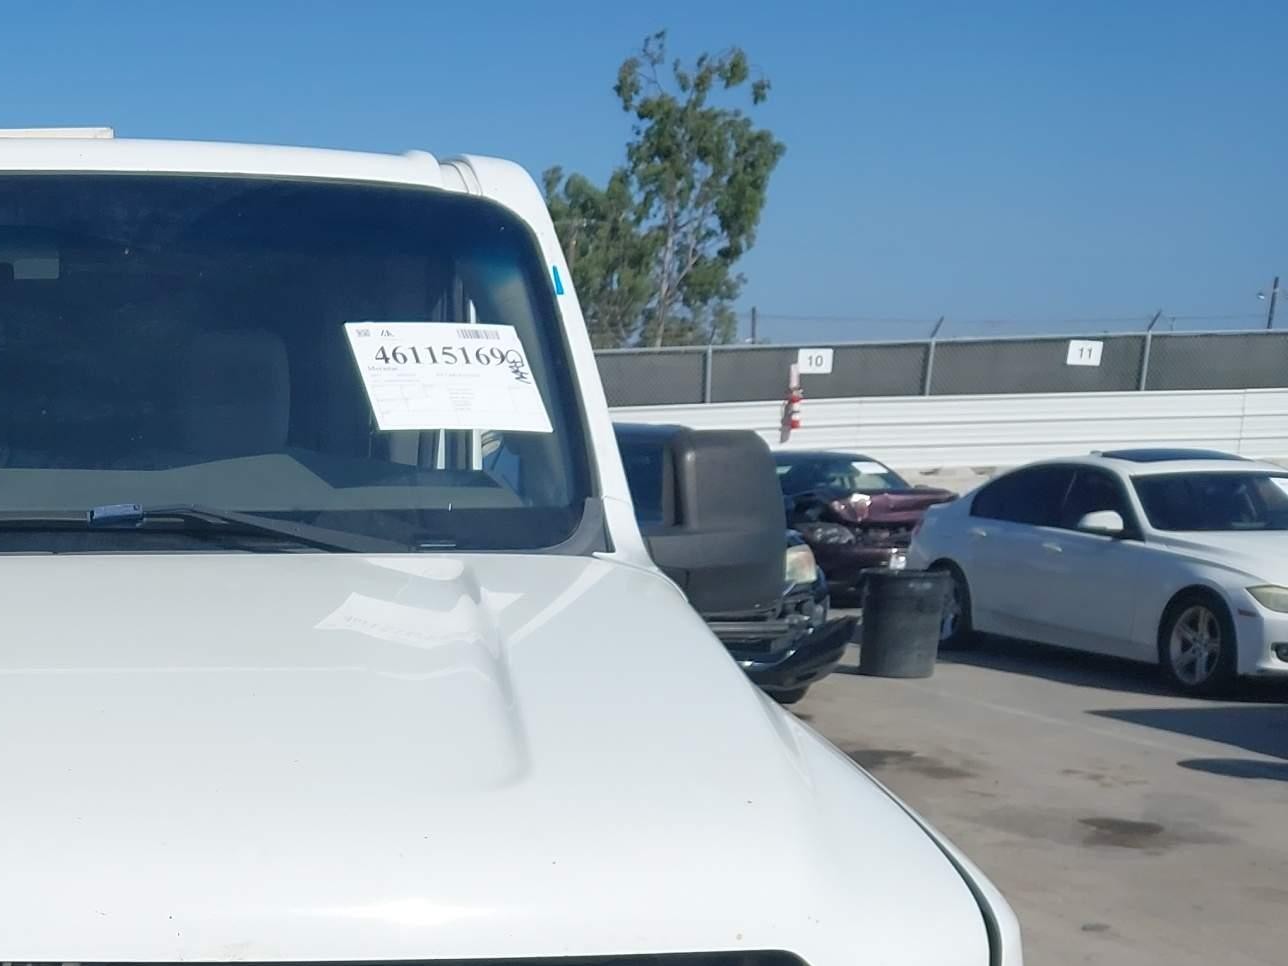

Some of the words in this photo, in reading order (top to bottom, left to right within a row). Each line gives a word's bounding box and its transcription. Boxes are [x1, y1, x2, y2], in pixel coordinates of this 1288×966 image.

[374, 345, 507, 365] 46115169
[1079, 346, 1093, 359] 11
[807, 355, 824, 367] 10
